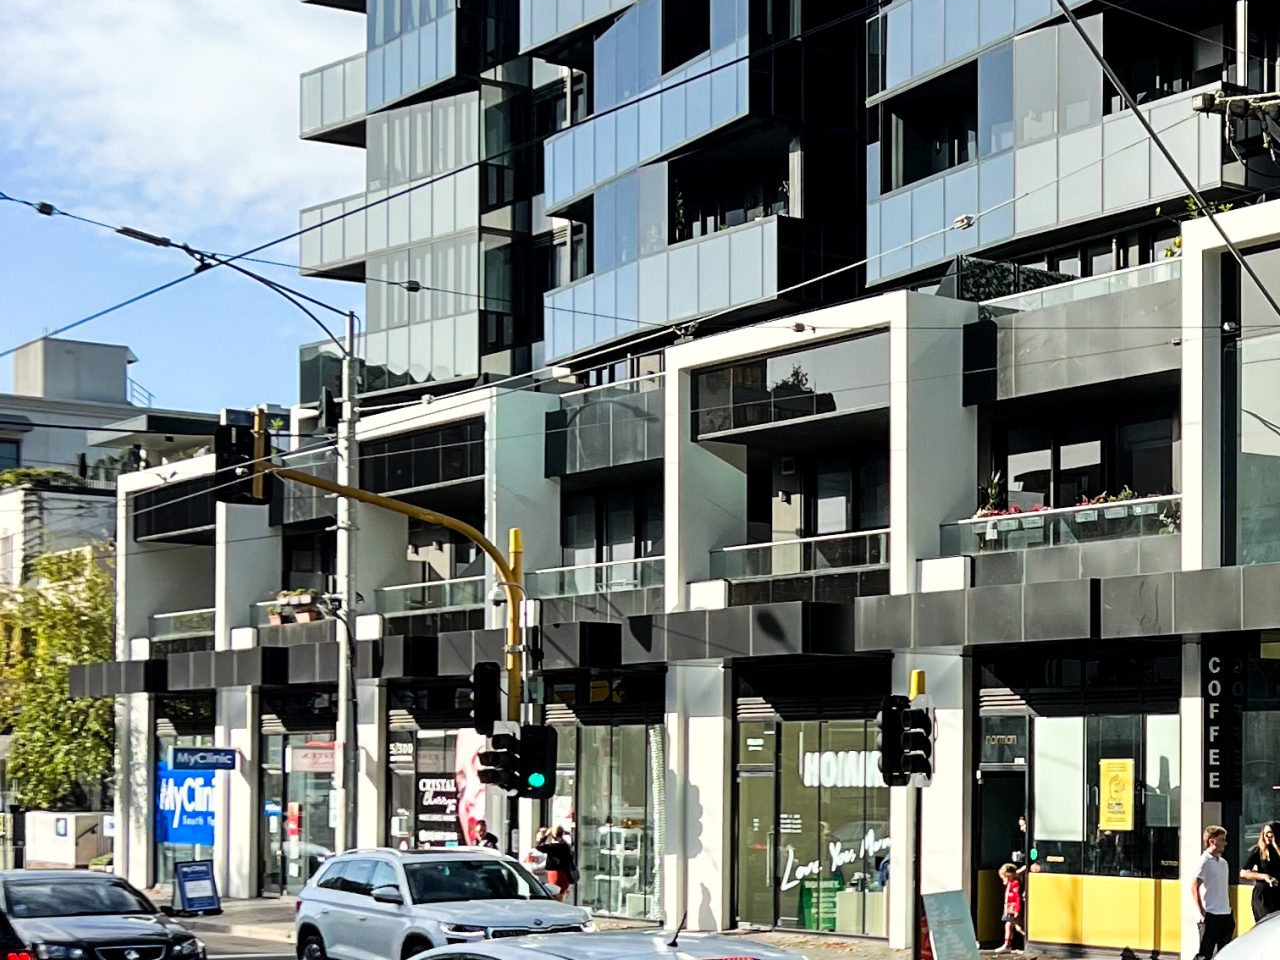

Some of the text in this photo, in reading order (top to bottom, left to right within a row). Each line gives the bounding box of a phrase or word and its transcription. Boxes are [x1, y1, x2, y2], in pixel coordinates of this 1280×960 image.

[1208, 657, 1221, 788] COFFEE
[176, 753, 233, 766] MyClinic
[419, 779, 456, 791] CRYSTAL
